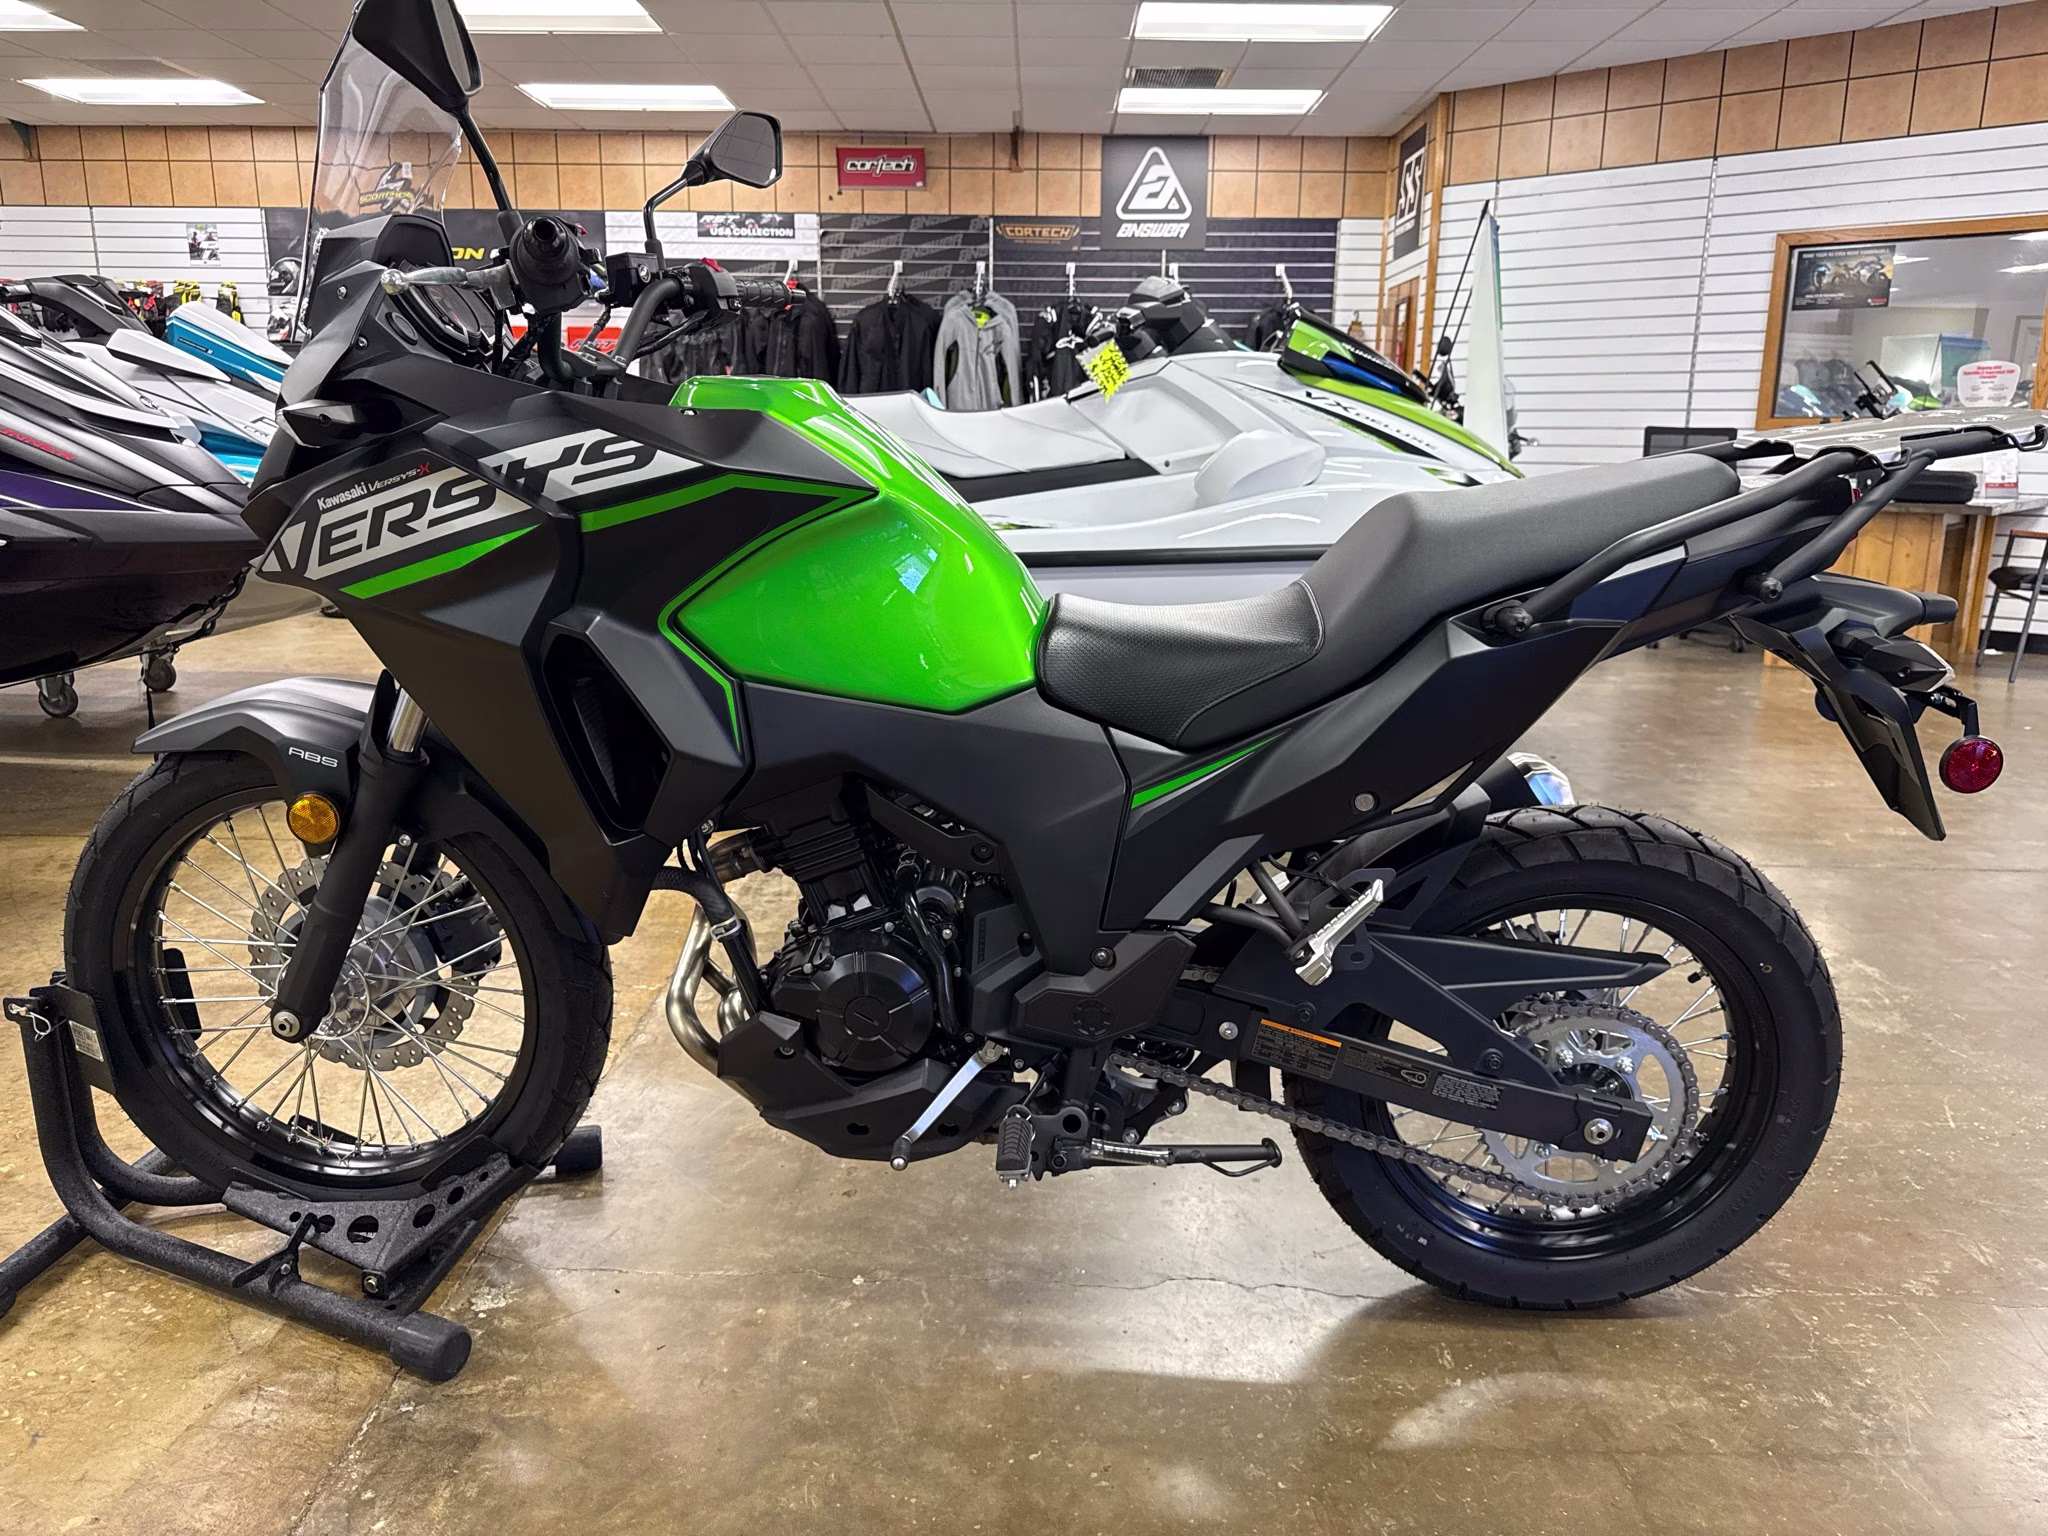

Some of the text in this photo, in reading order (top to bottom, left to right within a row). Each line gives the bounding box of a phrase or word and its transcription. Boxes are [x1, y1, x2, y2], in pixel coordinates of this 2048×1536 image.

[710, 228, 793, 237] USA COLLECTION
[1005, 227, 1071, 237] CORTECH
[1116, 223, 1190, 239] ANSWER
[1305, 390, 1356, 414] VX
[317, 462, 430, 510] Kawasaki VERSYS-X
[272, 436, 657, 577] VERSYS
[288, 747, 338, 768] ABS
